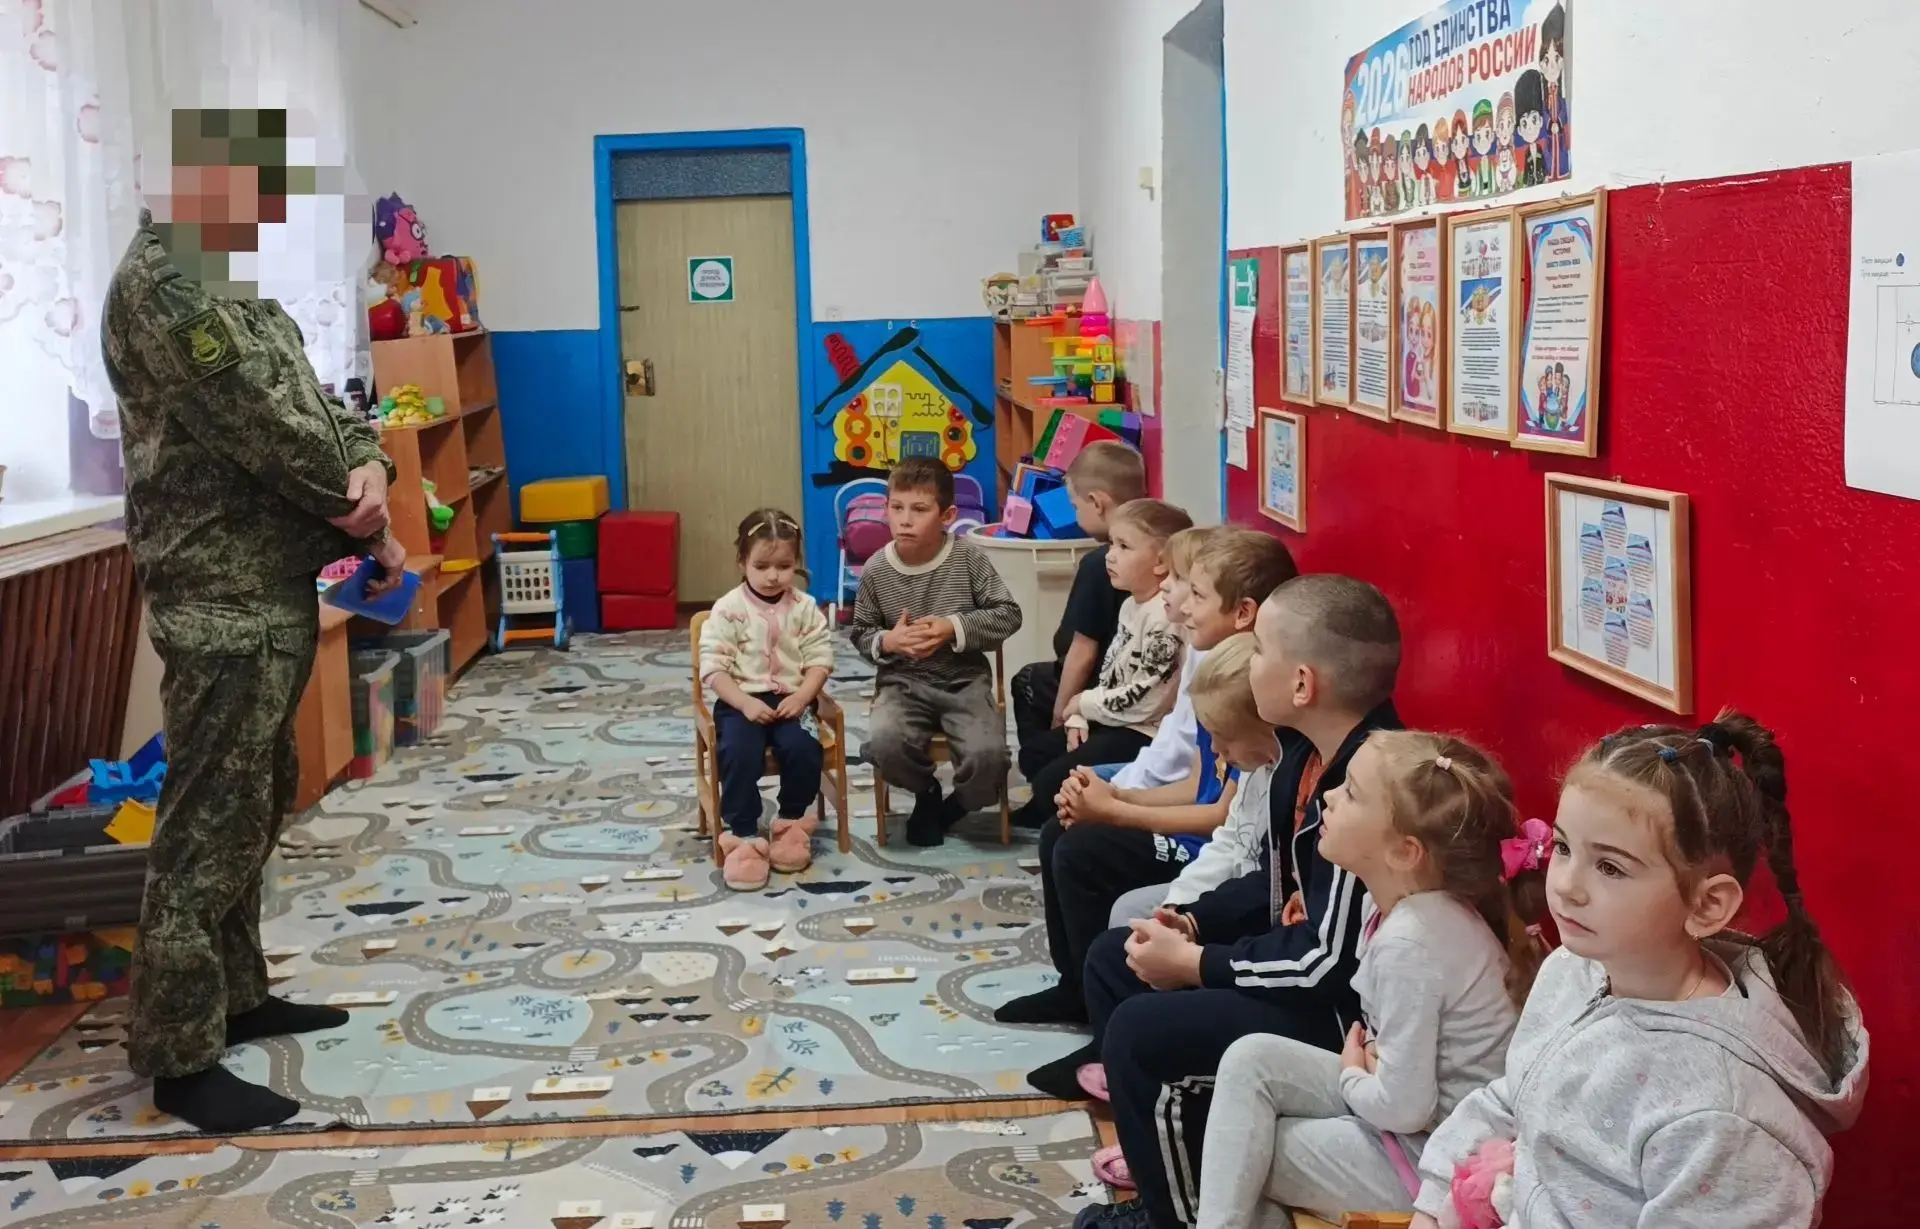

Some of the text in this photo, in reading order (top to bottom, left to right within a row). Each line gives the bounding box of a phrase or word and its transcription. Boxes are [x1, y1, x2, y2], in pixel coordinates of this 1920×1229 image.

[1408, 0, 1511, 69] ГОД ЕДИНСТВА
[1408, 23, 1538, 108] НАРОДОВ РОССИИ
[1355, 43, 1408, 127] 2026
